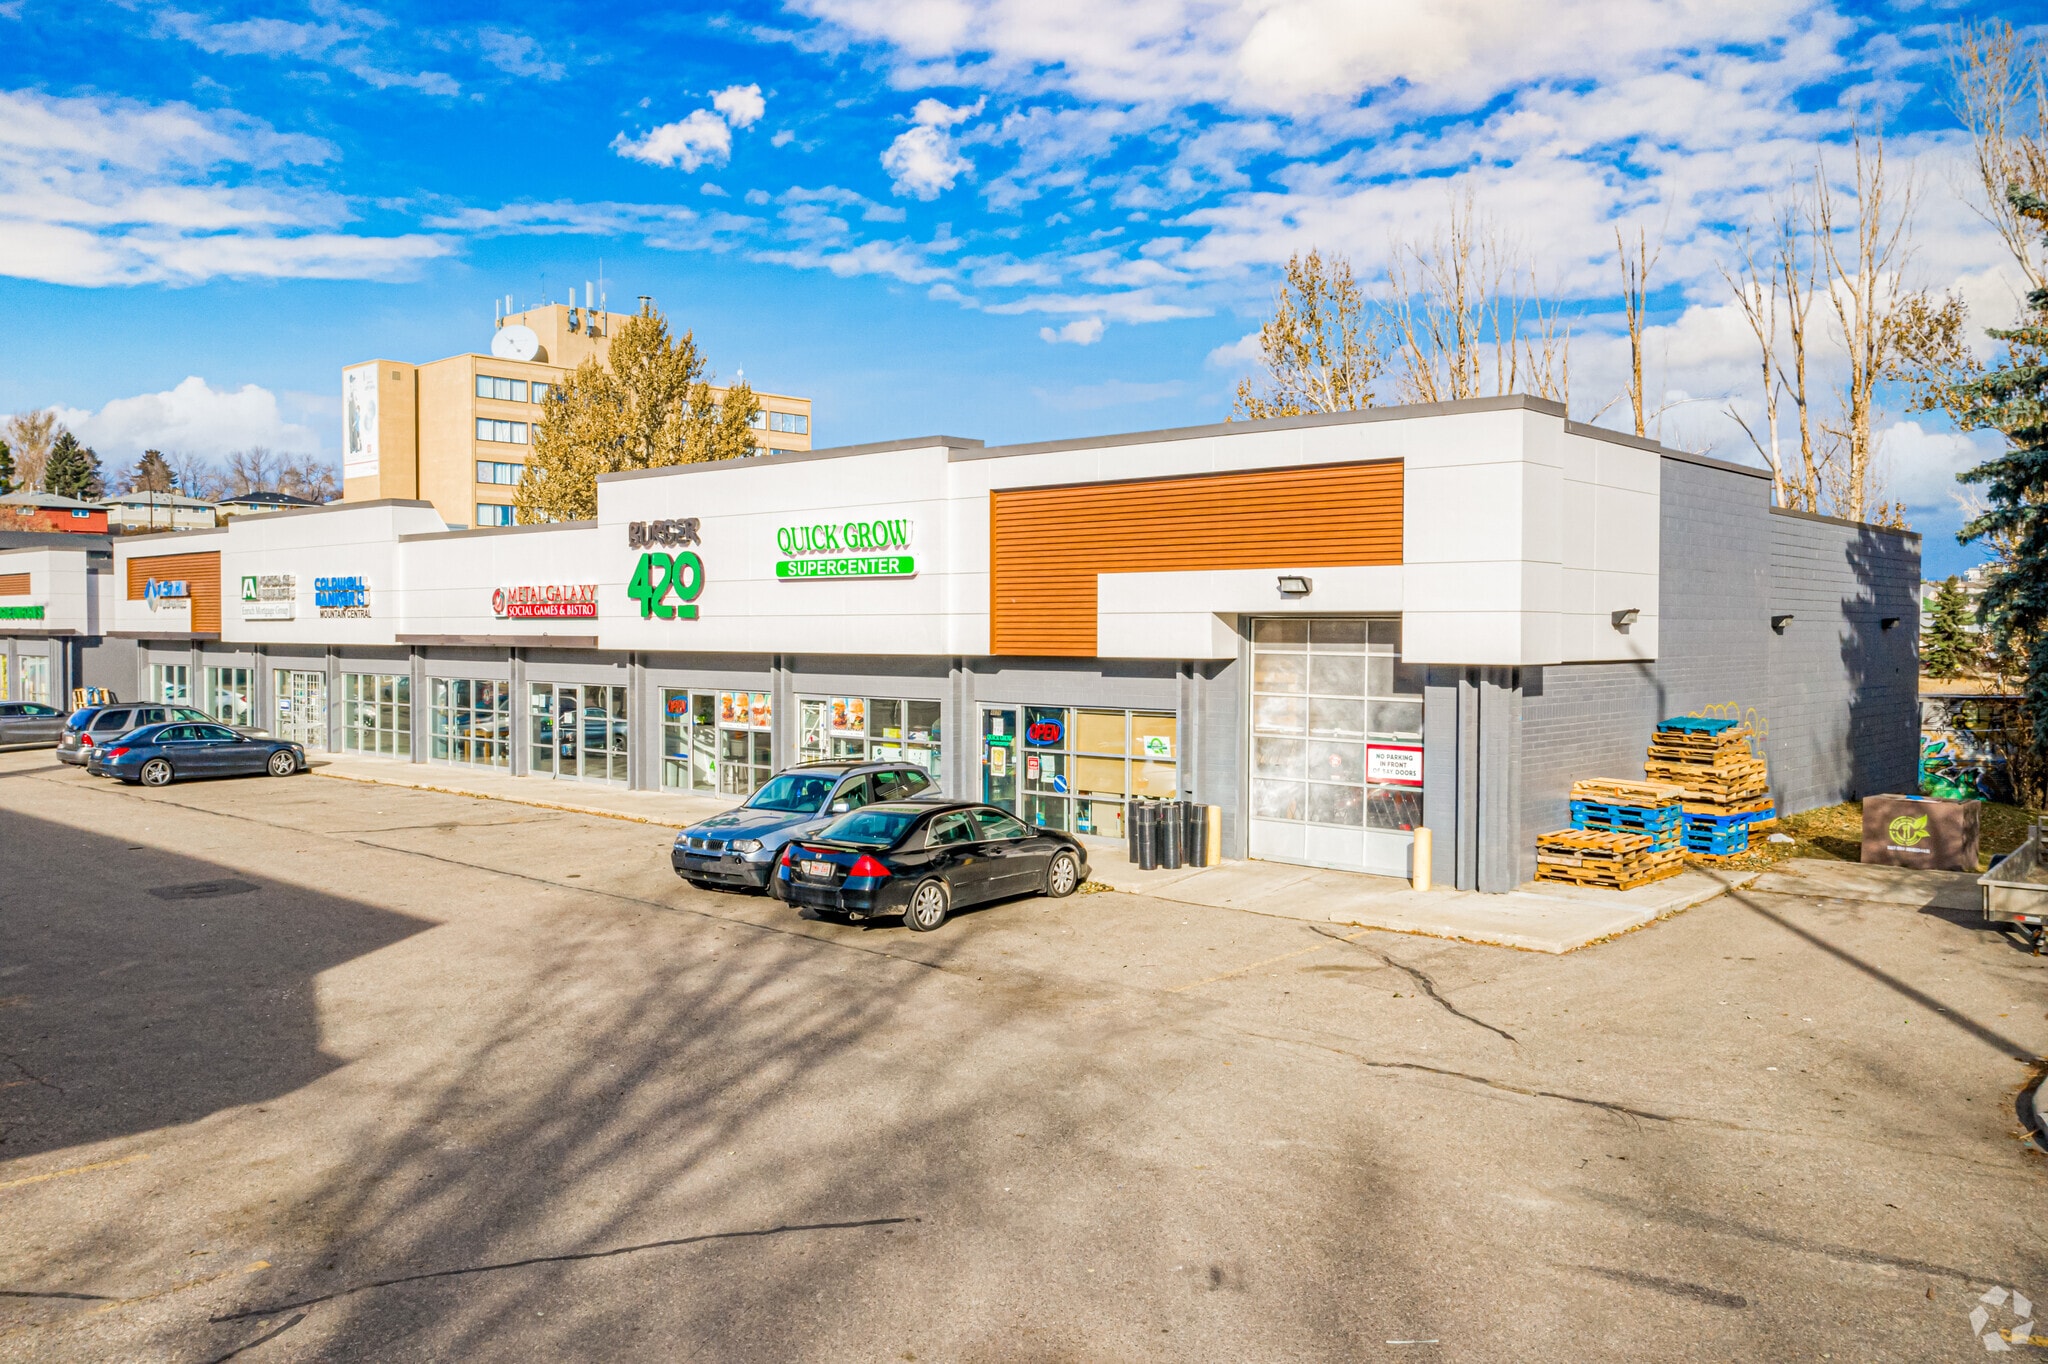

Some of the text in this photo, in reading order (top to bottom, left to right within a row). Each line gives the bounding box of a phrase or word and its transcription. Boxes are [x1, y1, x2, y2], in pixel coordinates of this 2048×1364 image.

[628, 517, 701, 549] BURGER
[777, 518, 907, 555] QUICK GROW
[787, 557, 900, 576] SUPERCENTER
[508, 584, 597, 602] METAL GALAXY
[627, 550, 702, 619] 420
[320, 609, 346, 619] MOUNTAIN
[508, 604, 594, 616] SOCIAL GAMES & BISTRO
[1029, 723, 1060, 742] OPEN
